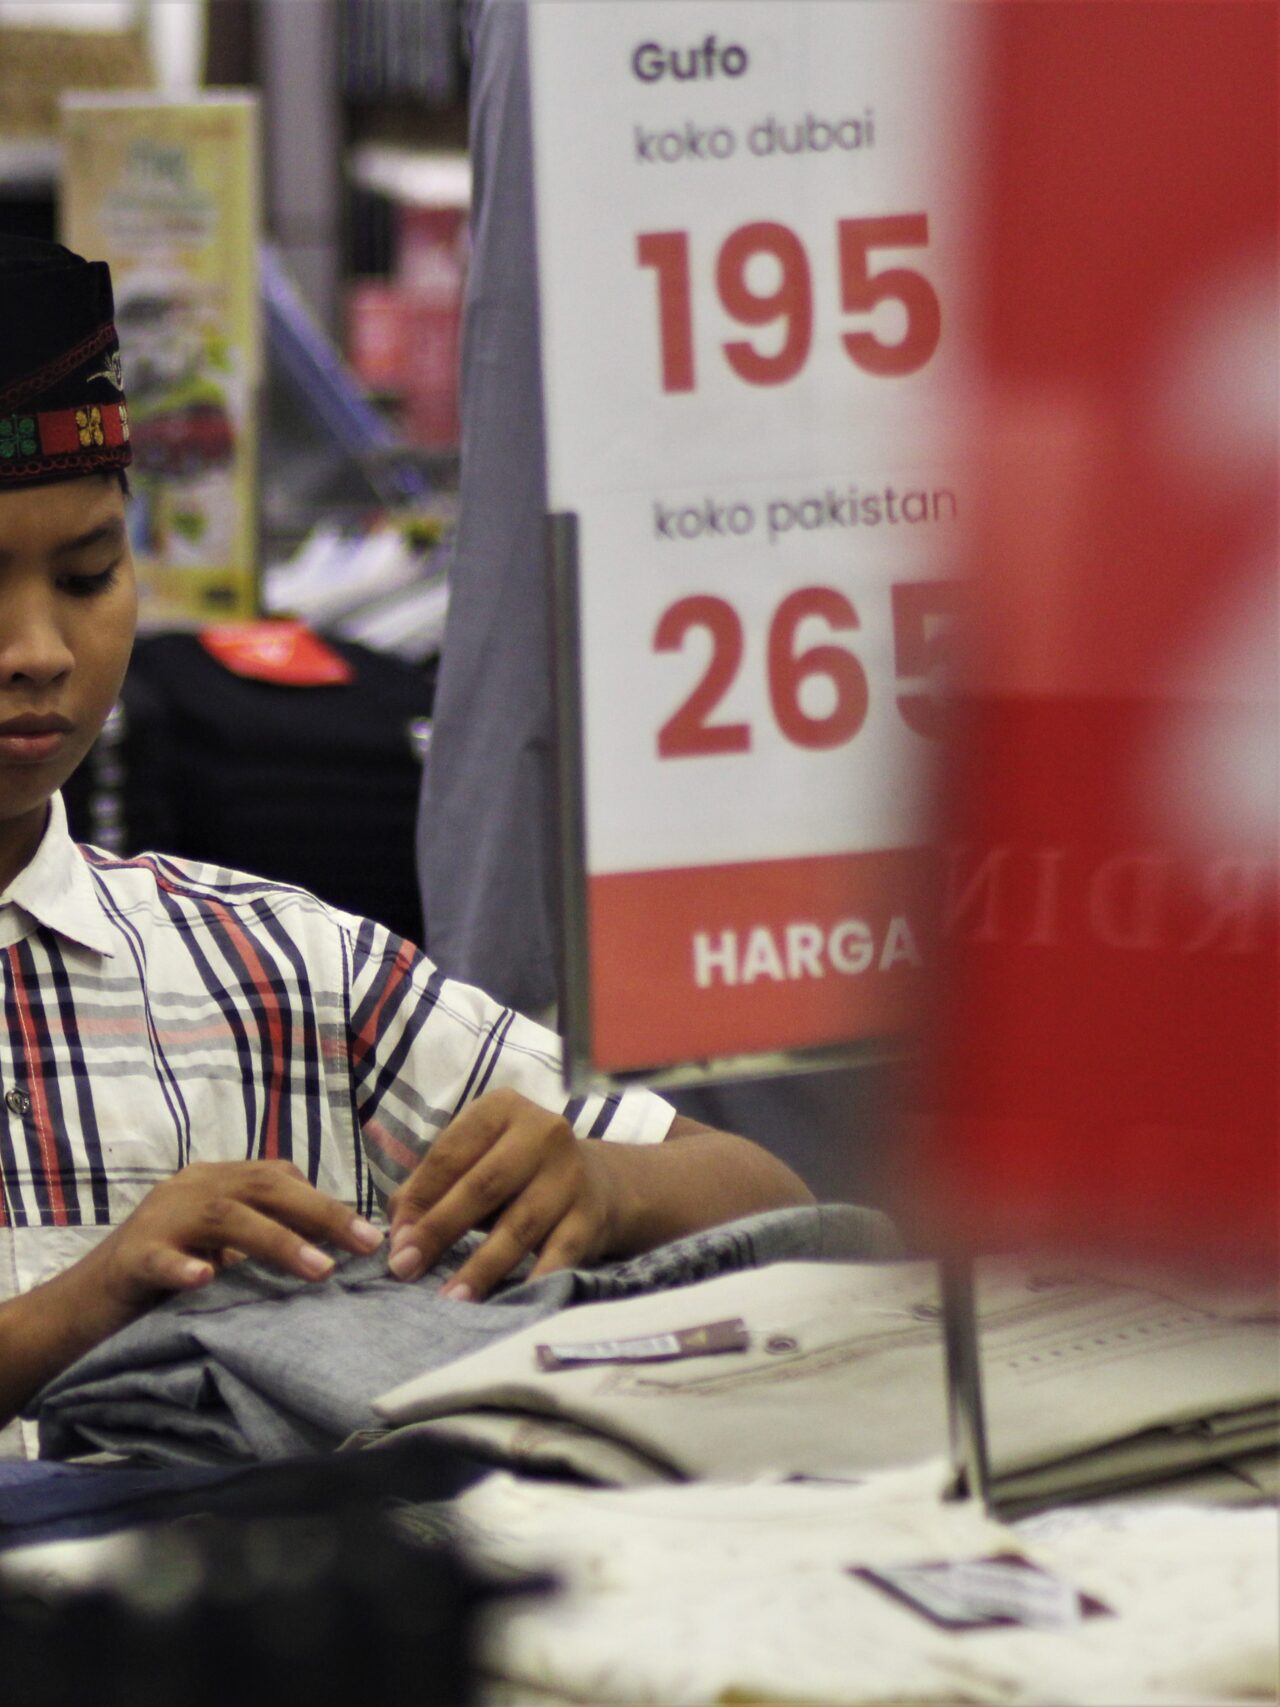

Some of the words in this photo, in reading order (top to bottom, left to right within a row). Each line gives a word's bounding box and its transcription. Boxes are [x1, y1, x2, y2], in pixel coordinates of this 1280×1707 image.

[631, 36, 748, 83] Gufo
[634, 121, 735, 163] koko
[747, 110, 875, 156] dubai
[635, 212, 943, 394] 195
[652, 498, 754, 541] koko
[767, 484, 959, 543] pakistan
[693, 916, 923, 989] HARGA
